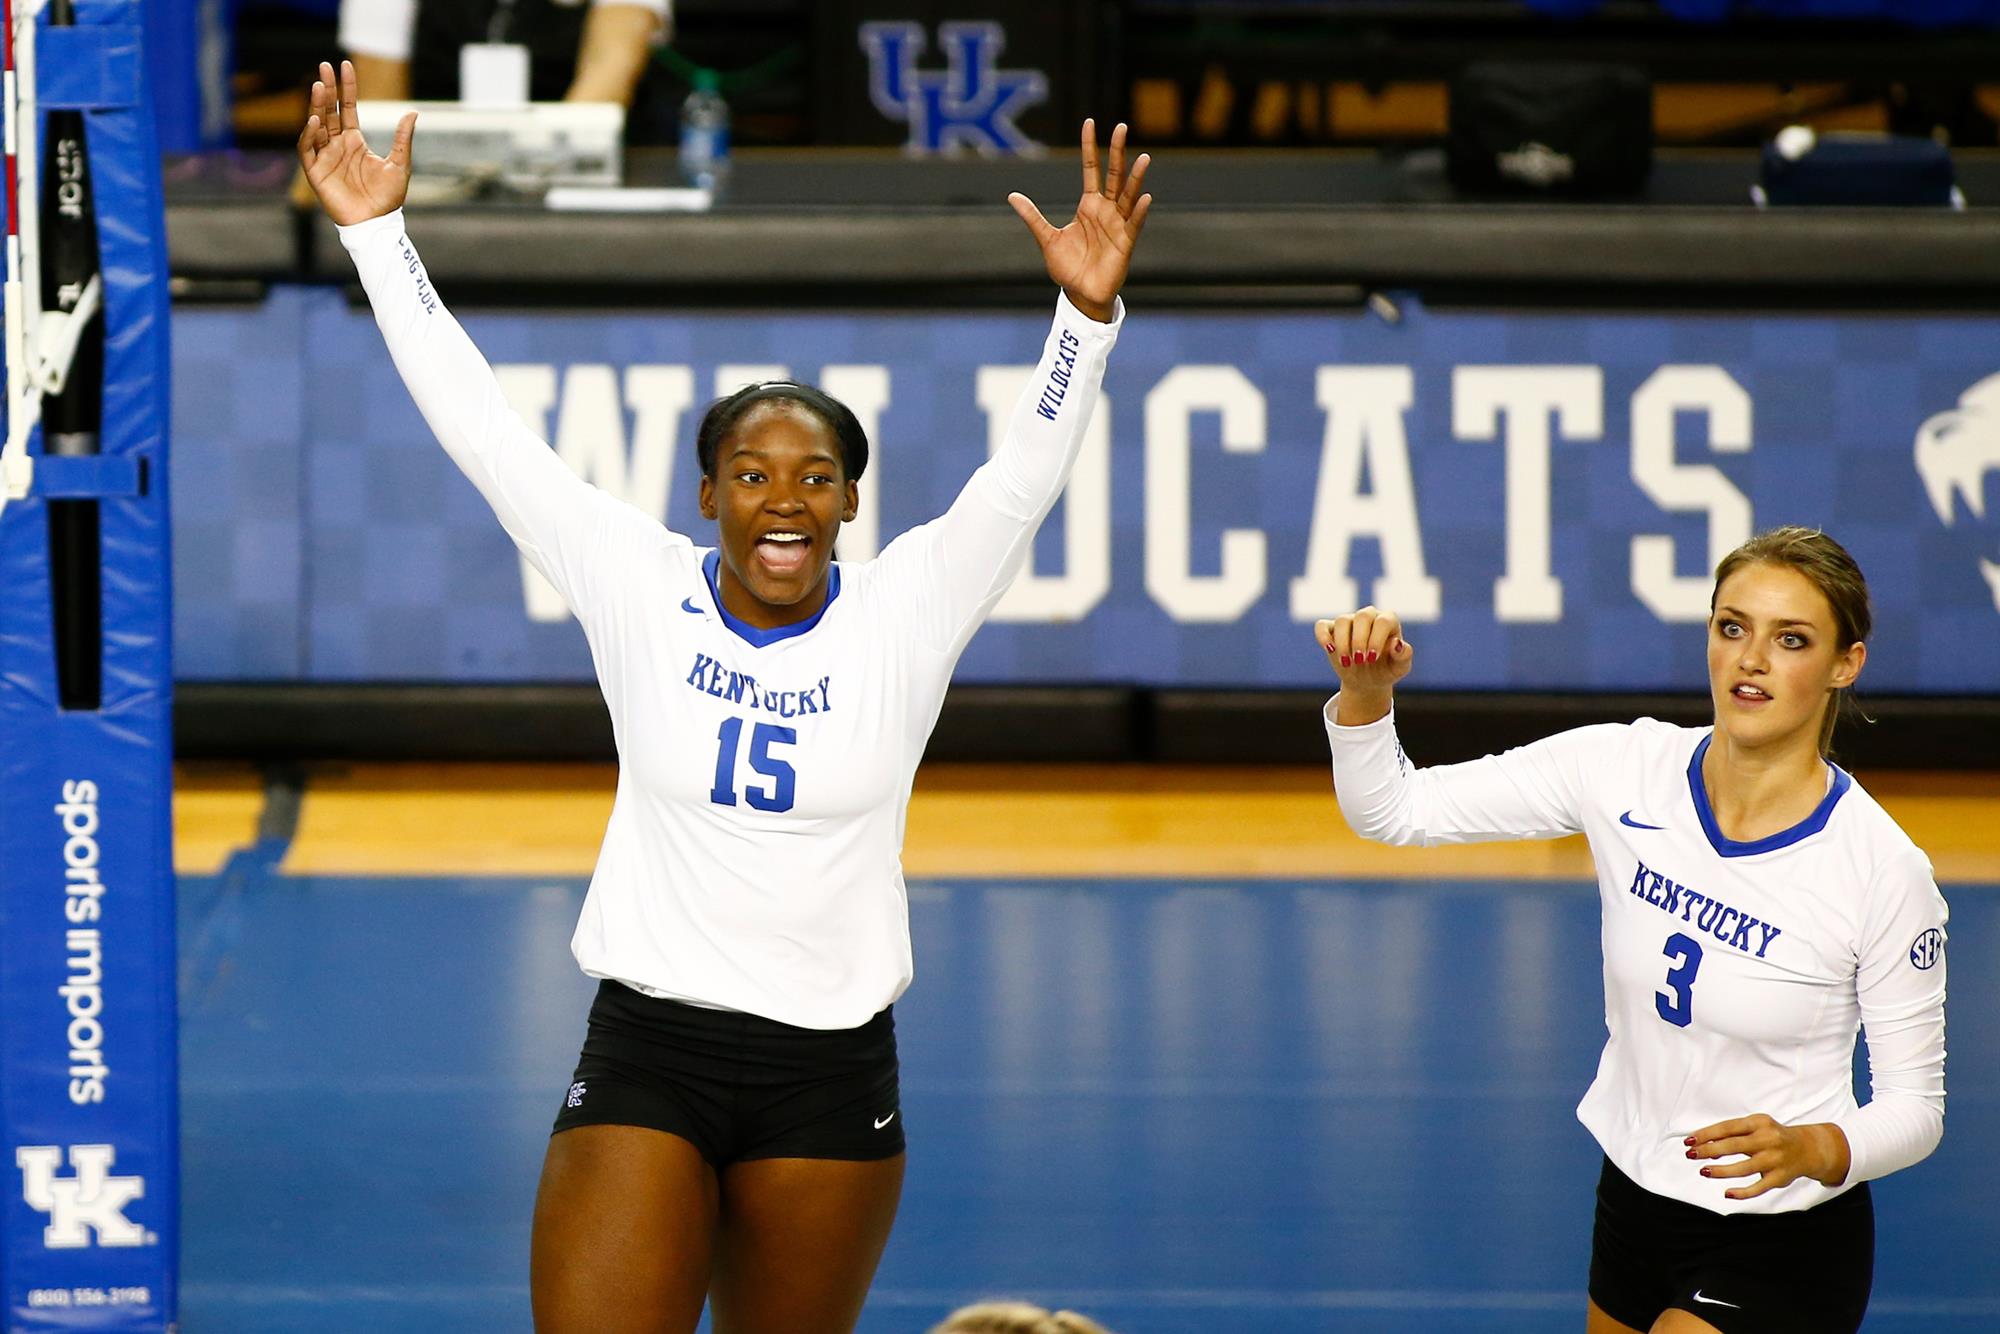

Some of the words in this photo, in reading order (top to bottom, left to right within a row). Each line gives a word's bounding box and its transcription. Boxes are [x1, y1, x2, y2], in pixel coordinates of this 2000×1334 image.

[858, 21, 1049, 160] UK
[1037, 329, 1079, 421] WILDCATS
[686, 653, 831, 718] KENTUCKY
[711, 716, 796, 813] 15
[55, 779, 106, 923] sports
[1630, 861, 1781, 958] KENTUCKY
[58, 929, 110, 1105] imports
[1655, 932, 1703, 1028] 3
[16, 1145, 145, 1248] UK
